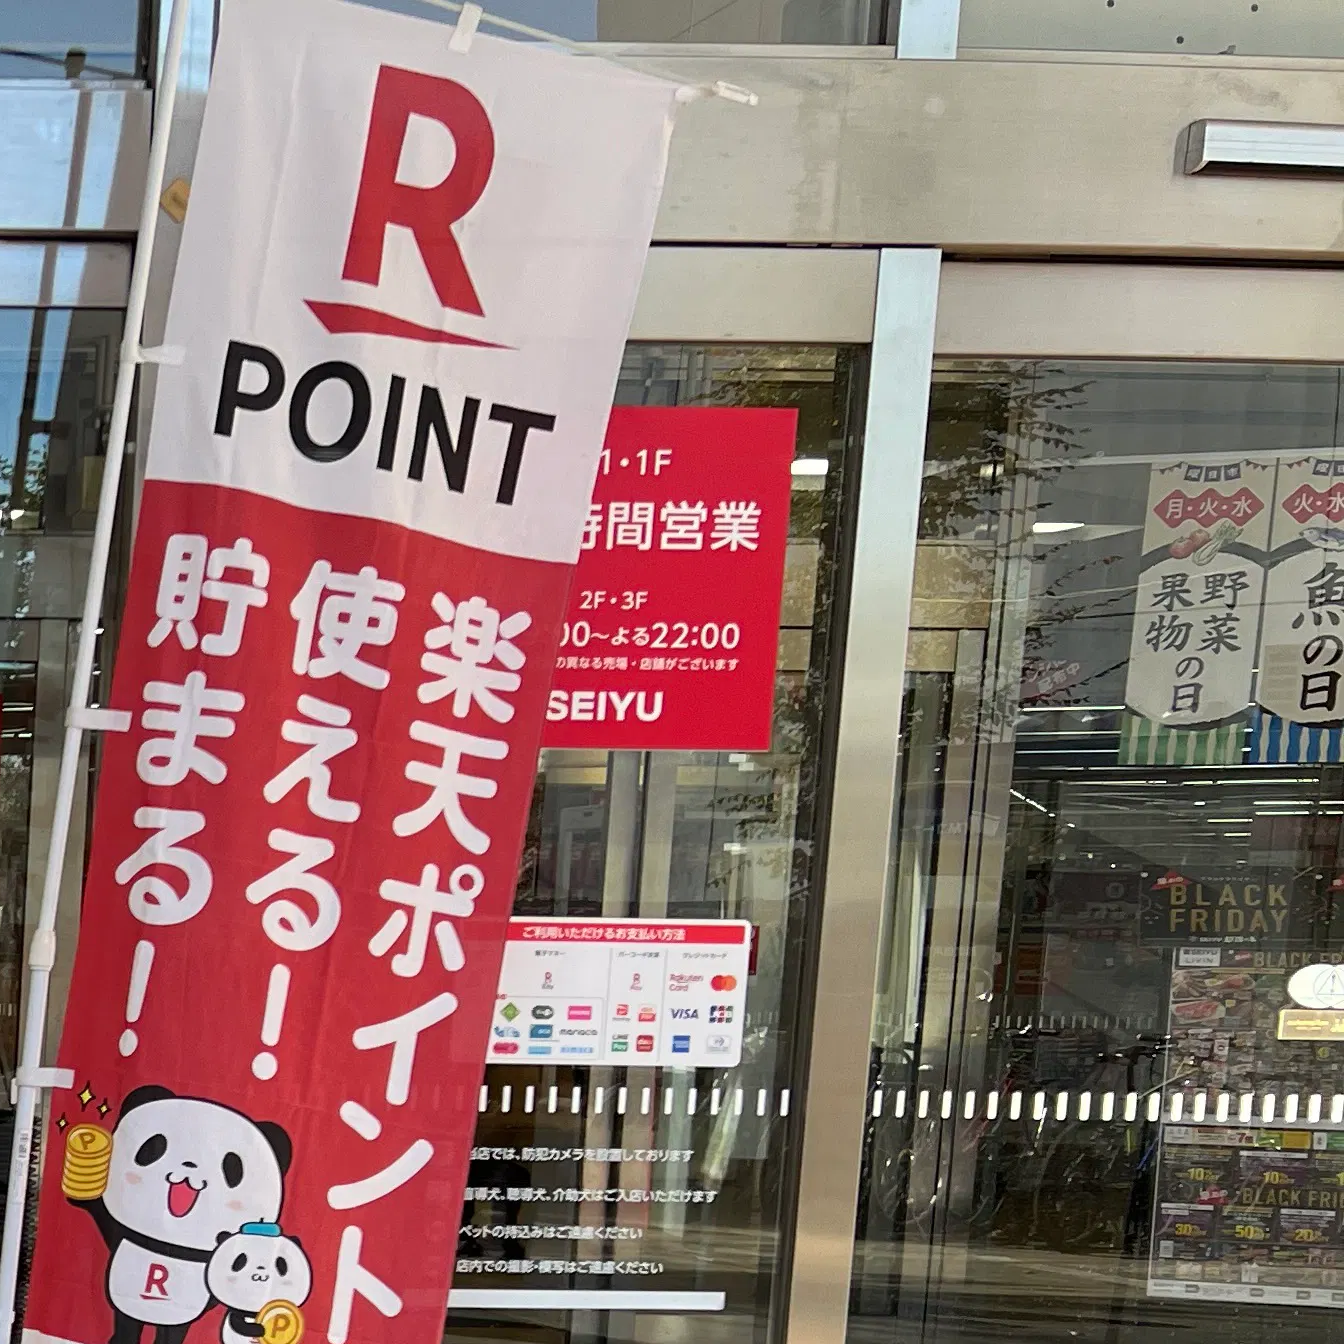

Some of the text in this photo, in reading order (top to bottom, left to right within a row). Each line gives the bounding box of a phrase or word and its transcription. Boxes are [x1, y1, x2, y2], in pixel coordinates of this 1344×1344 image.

[340, 63, 496, 318] R
[212, 339, 557, 506] POINT
[1165, 496, 1254, 520] 月・火・水
[579, 590, 649, 611] 2F・3F
[1145, 572, 1194, 653] 果物
[1195, 570, 1250, 655] 野菜
[545, 690, 664, 722] SEIYU
[114, 533, 272, 1059] 貯まる！
[245, 558, 407, 1082] 使える！
[1169, 883, 1288, 906] BLACK
[522, 926, 687, 941] ご利用いただけるお支払い方法
[1169, 908, 1288, 933] FRIDAY
[670, 1008, 700, 1020] VISA
[1241, 1186, 1301, 1206] BLACK
[143, 1263, 170, 1296] R
